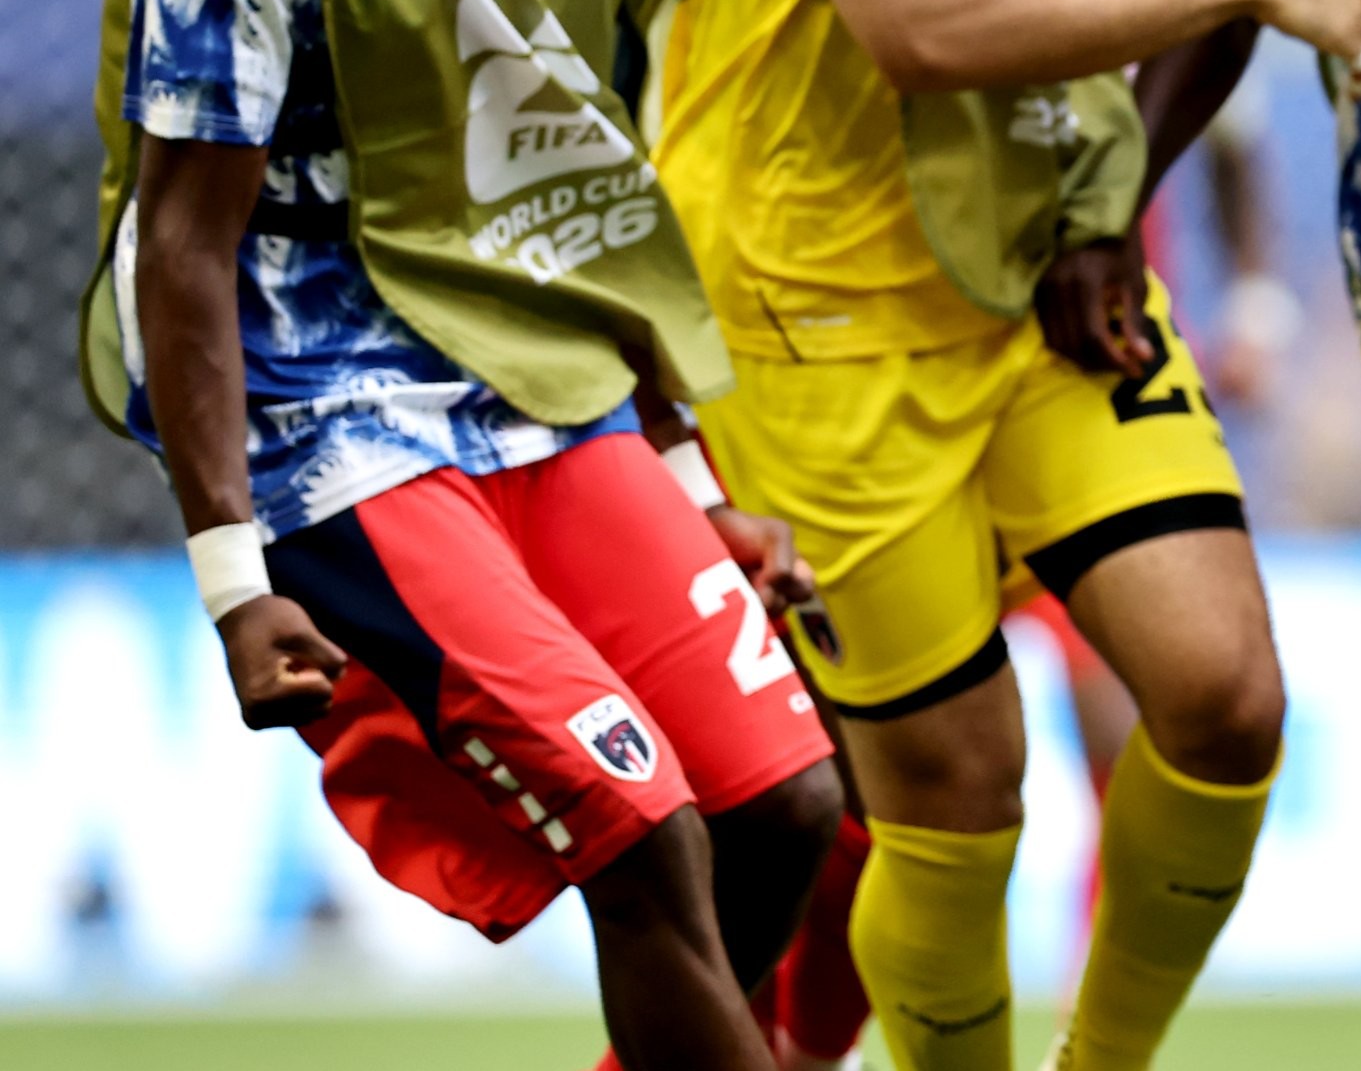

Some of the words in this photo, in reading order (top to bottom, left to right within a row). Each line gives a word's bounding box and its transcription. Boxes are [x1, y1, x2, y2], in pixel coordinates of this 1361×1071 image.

[507, 121, 607, 160] FIFA
[469, 186, 577, 261] WORLD
[506, 196, 658, 286] 026
